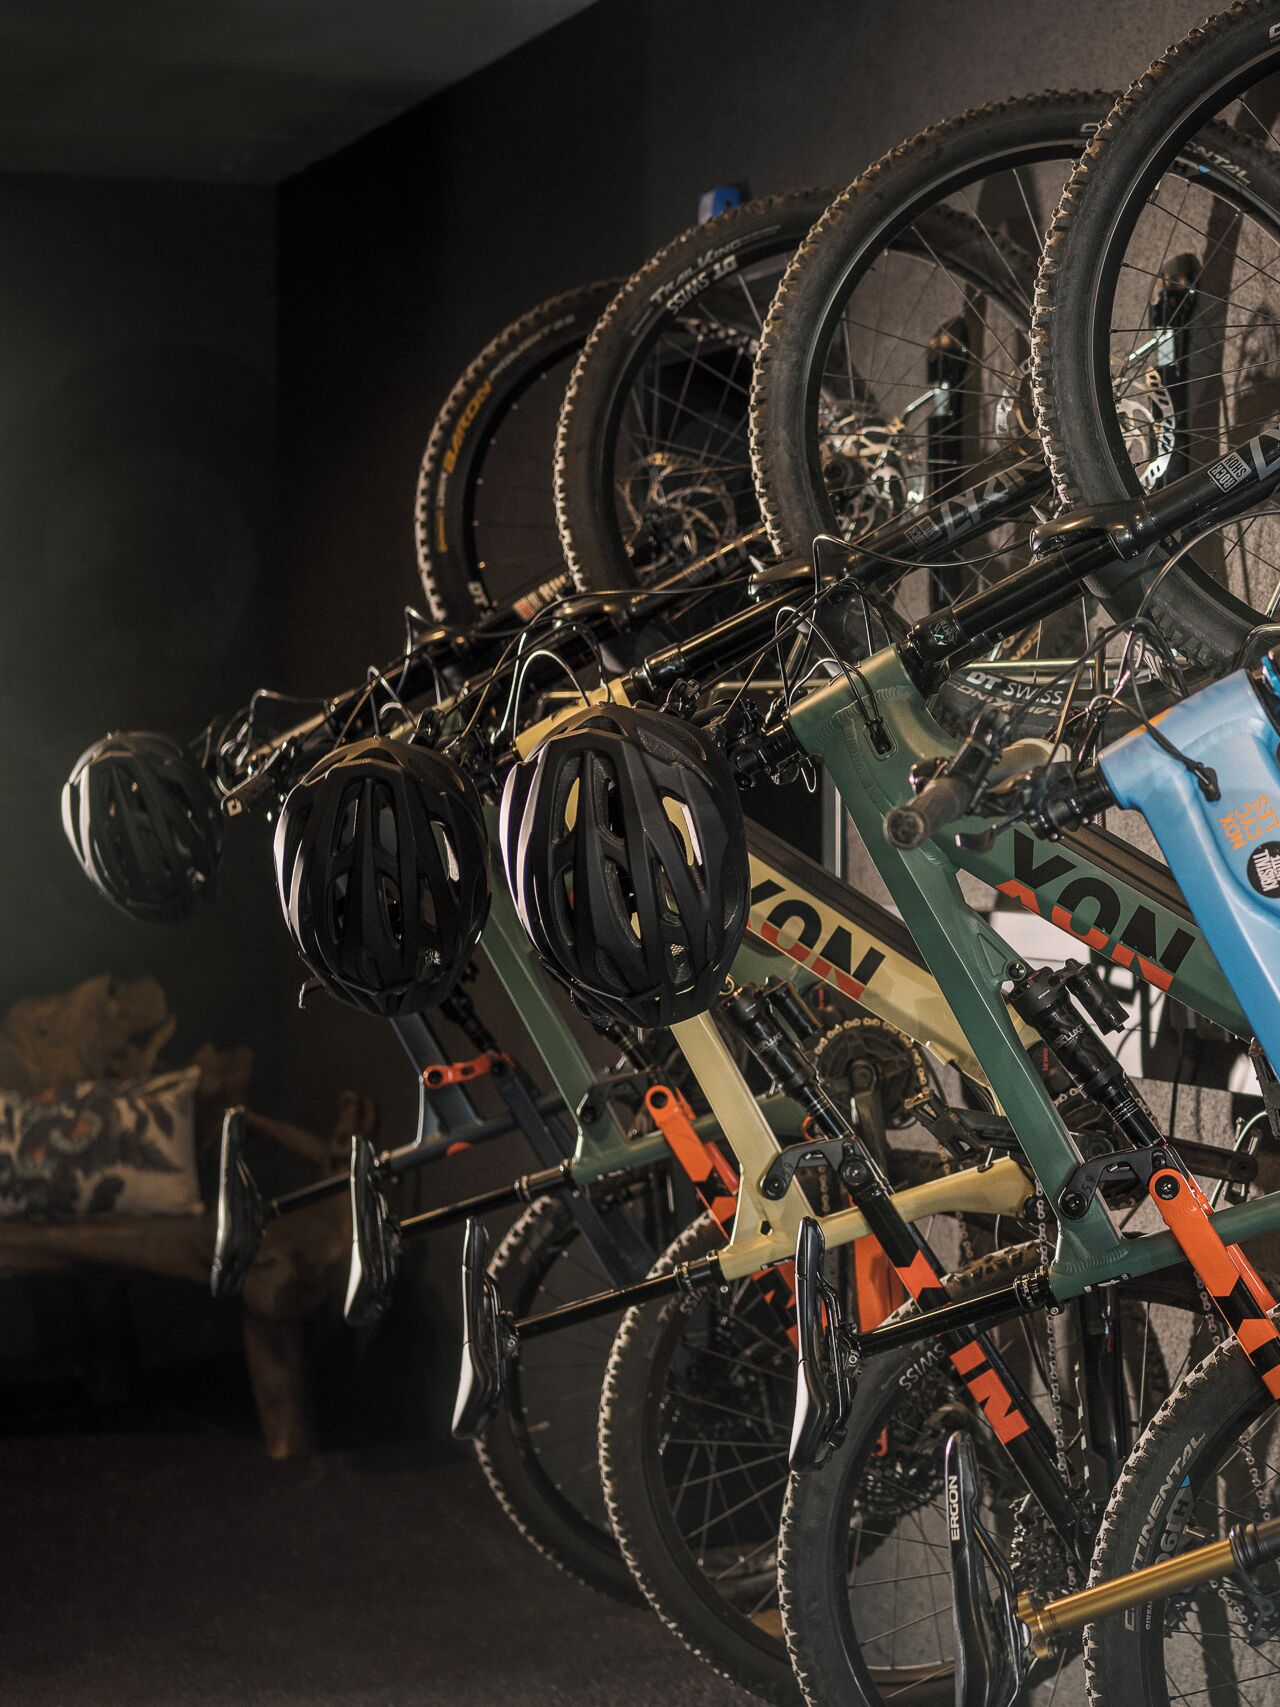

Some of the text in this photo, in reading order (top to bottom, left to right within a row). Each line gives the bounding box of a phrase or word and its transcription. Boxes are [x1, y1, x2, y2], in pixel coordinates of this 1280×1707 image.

[1208, 464, 1237, 490] ROCK
[966, 671, 1064, 706] DT SWSS
[1219, 811, 1247, 850] NOX
[1252, 849, 1280, 892] KRISTALL
[898, 1342, 946, 1391] SWISS
[948, 1475, 960, 1541] ERGON
